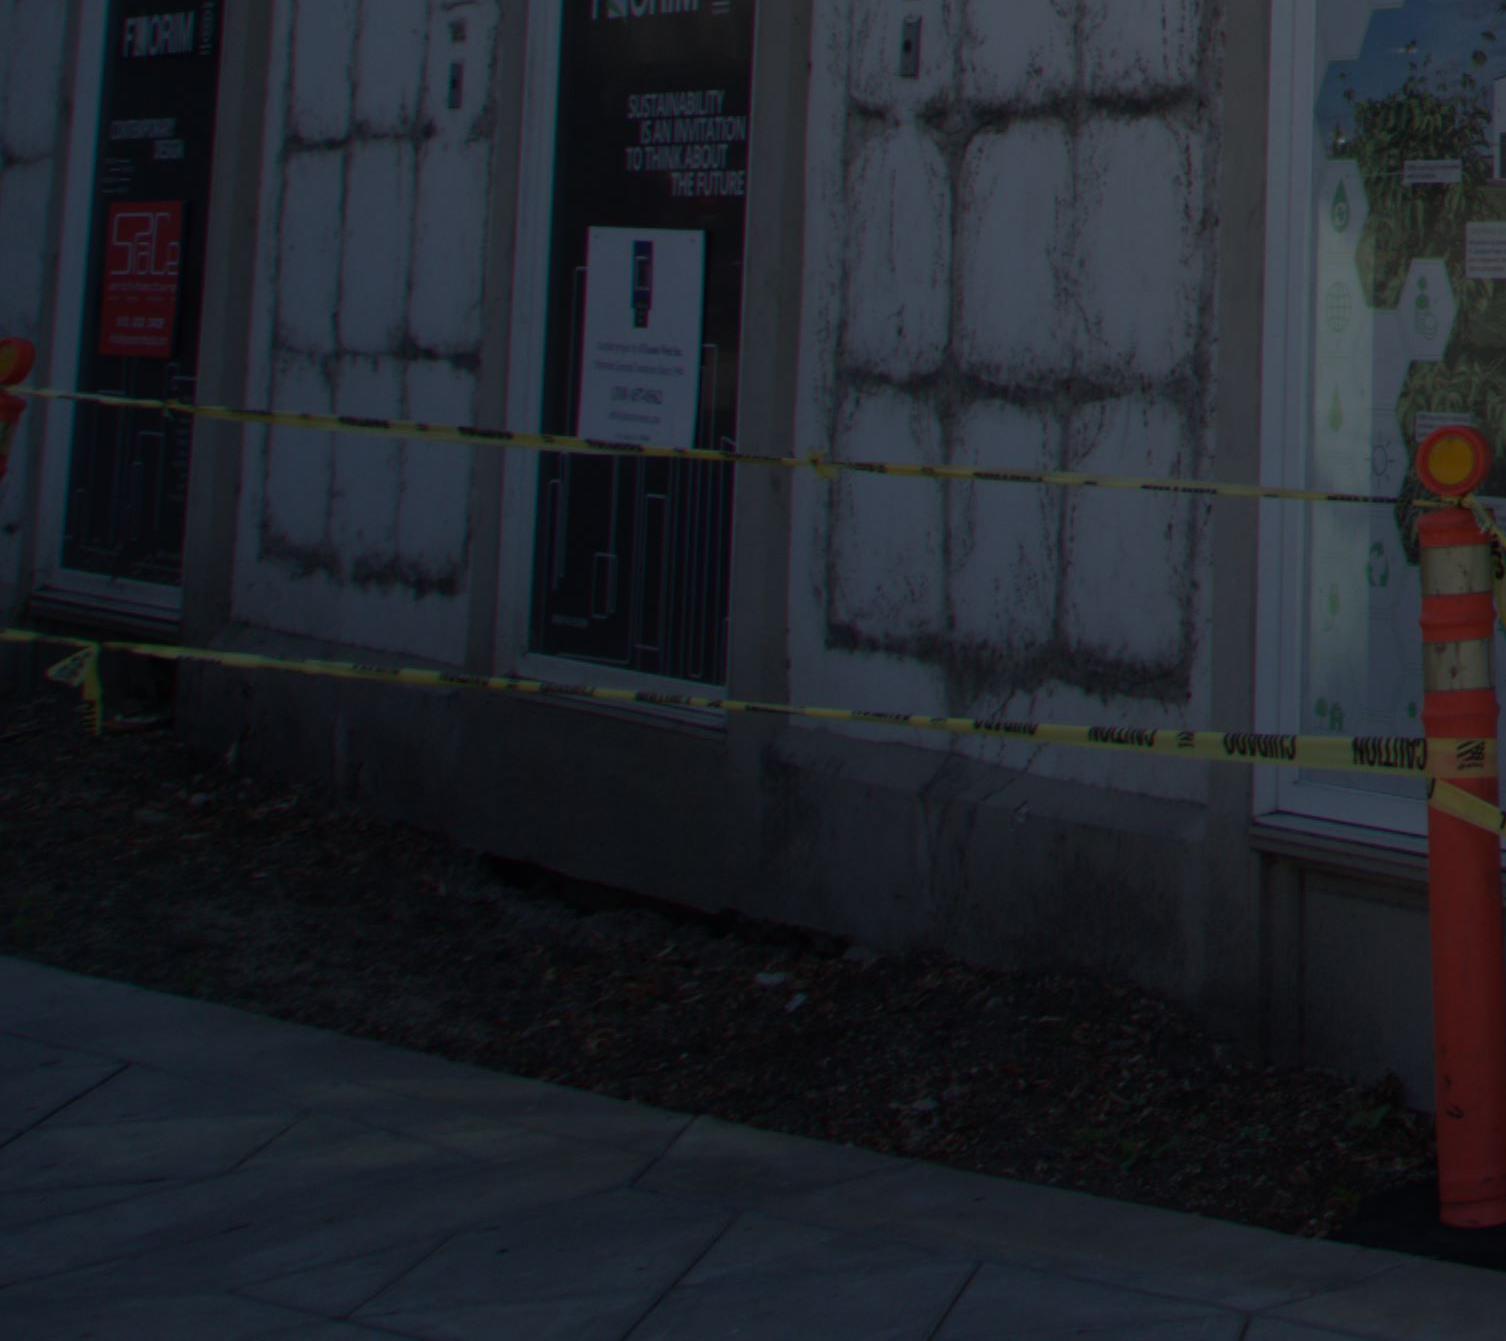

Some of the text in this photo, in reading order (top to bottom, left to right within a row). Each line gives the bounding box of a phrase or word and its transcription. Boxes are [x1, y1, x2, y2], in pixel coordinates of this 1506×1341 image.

[626, 90, 725, 119] SUSTAINABILITY
[640, 116, 748, 144] IS AN INVITATION
[625, 144, 728, 171] TO THINK ABOUT
[672, 169, 745, 197] THE FUTURE
[1352, 736, 1427, 771] CAUTION
